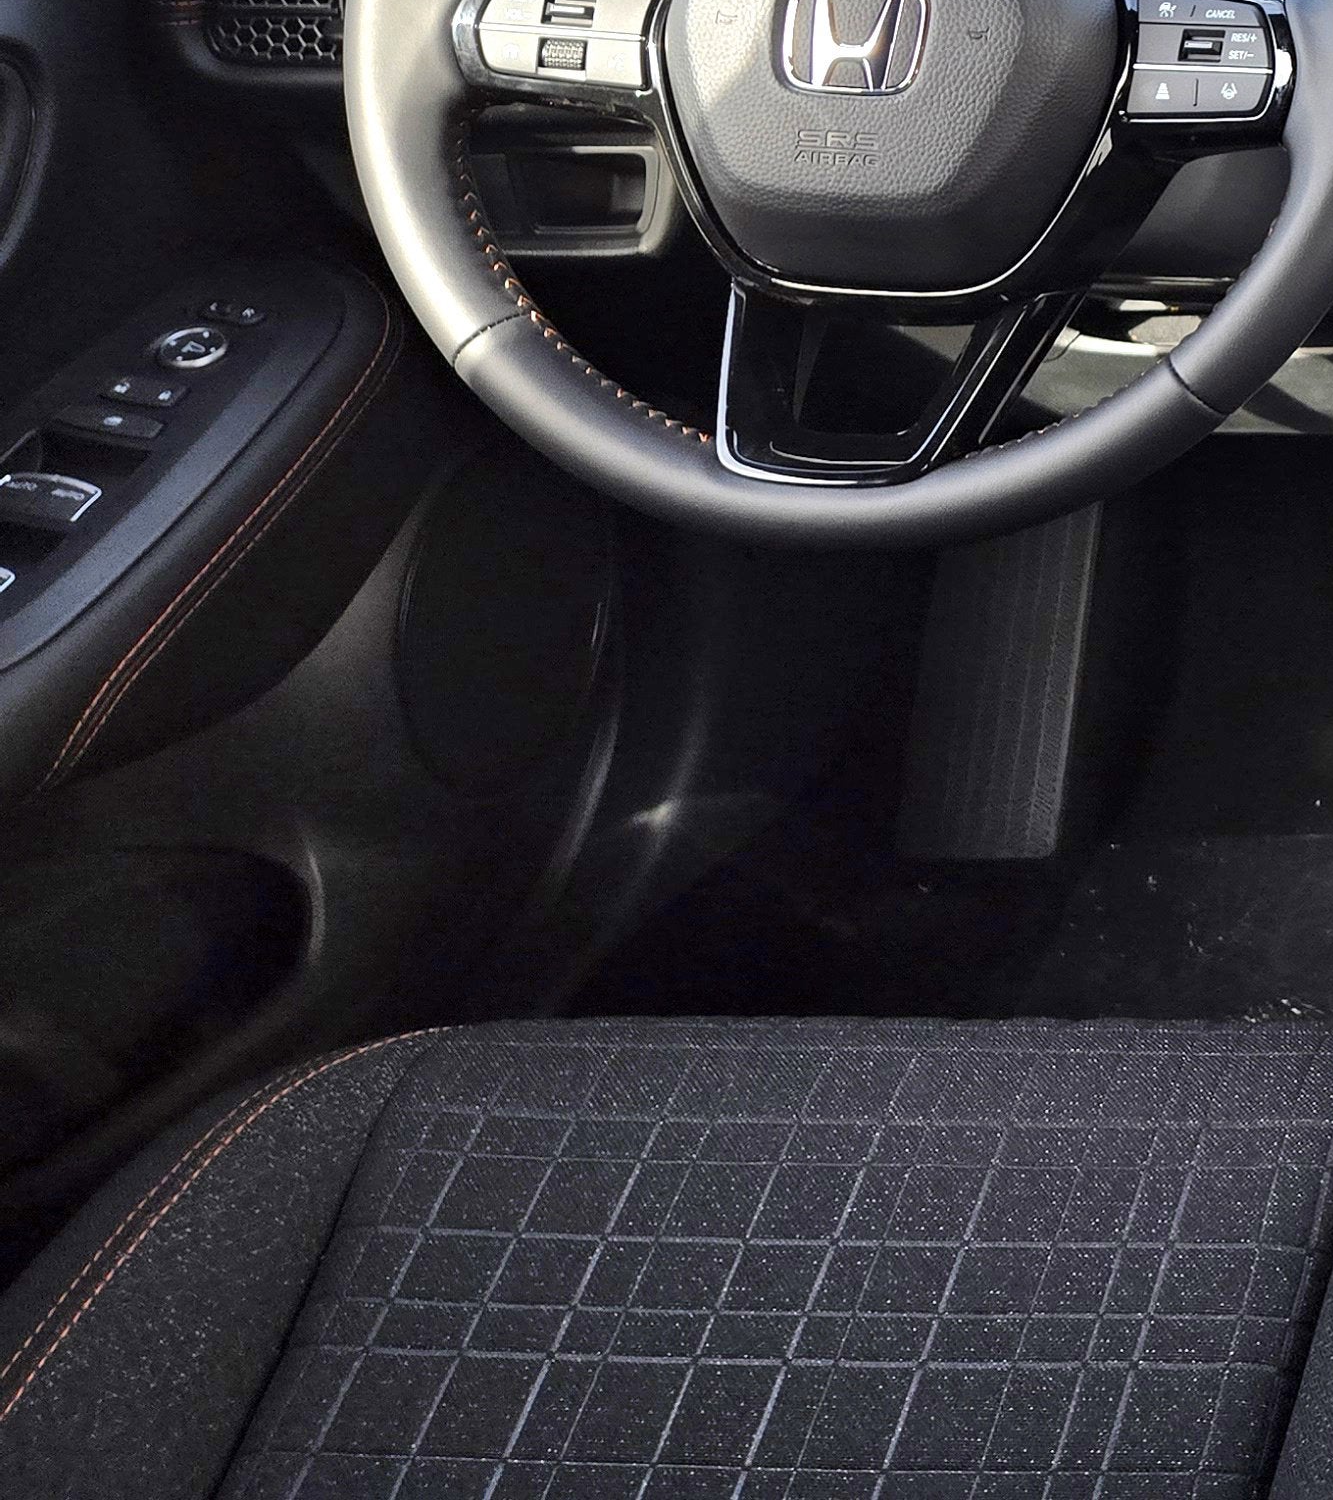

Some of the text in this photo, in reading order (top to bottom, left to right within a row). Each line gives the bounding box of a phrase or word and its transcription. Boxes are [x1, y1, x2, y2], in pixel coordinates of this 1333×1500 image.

[1205, 9, 1236, 19] CANCEL
[797, 130, 878, 150] SRS
[794, 151, 880, 167] AIRBAG
